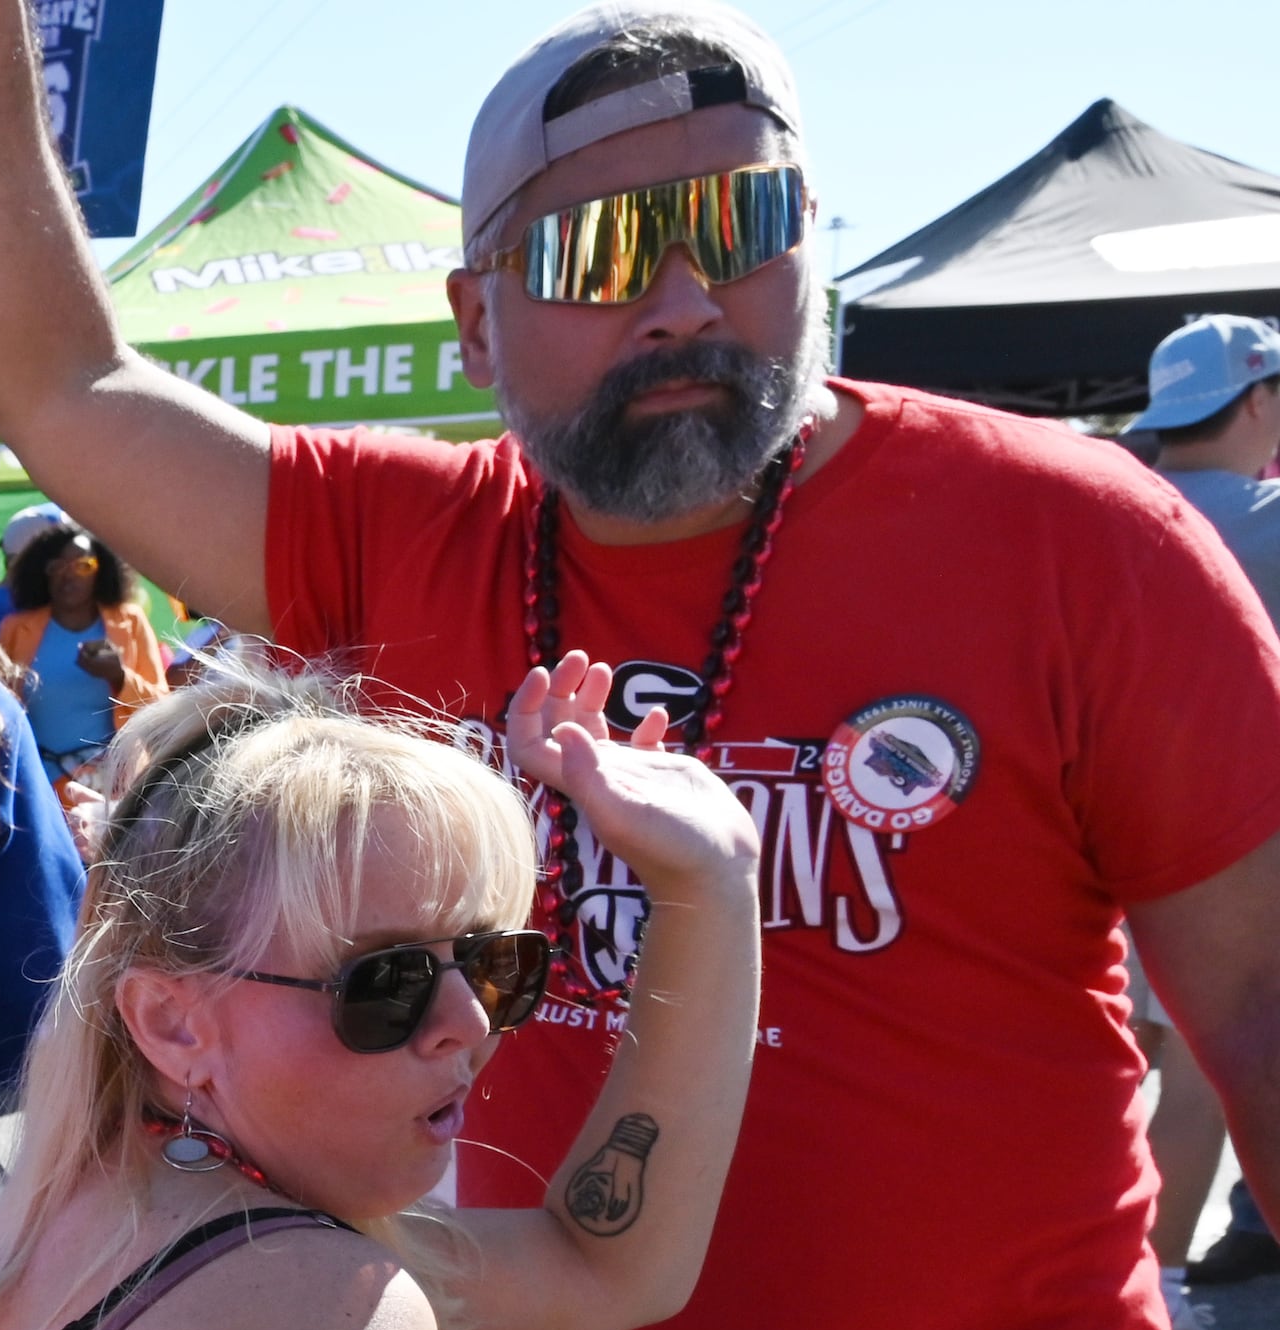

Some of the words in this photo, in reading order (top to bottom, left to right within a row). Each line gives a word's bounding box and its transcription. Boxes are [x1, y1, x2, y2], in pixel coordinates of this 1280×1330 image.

[150, 249, 365, 294] Mike
[384, 241, 465, 274] Ik
[300, 343, 415, 400] THE
[891, 699, 931, 711] SINCE
[826, 742, 887, 829] DAWGS!
[890, 806, 935, 830] GO
